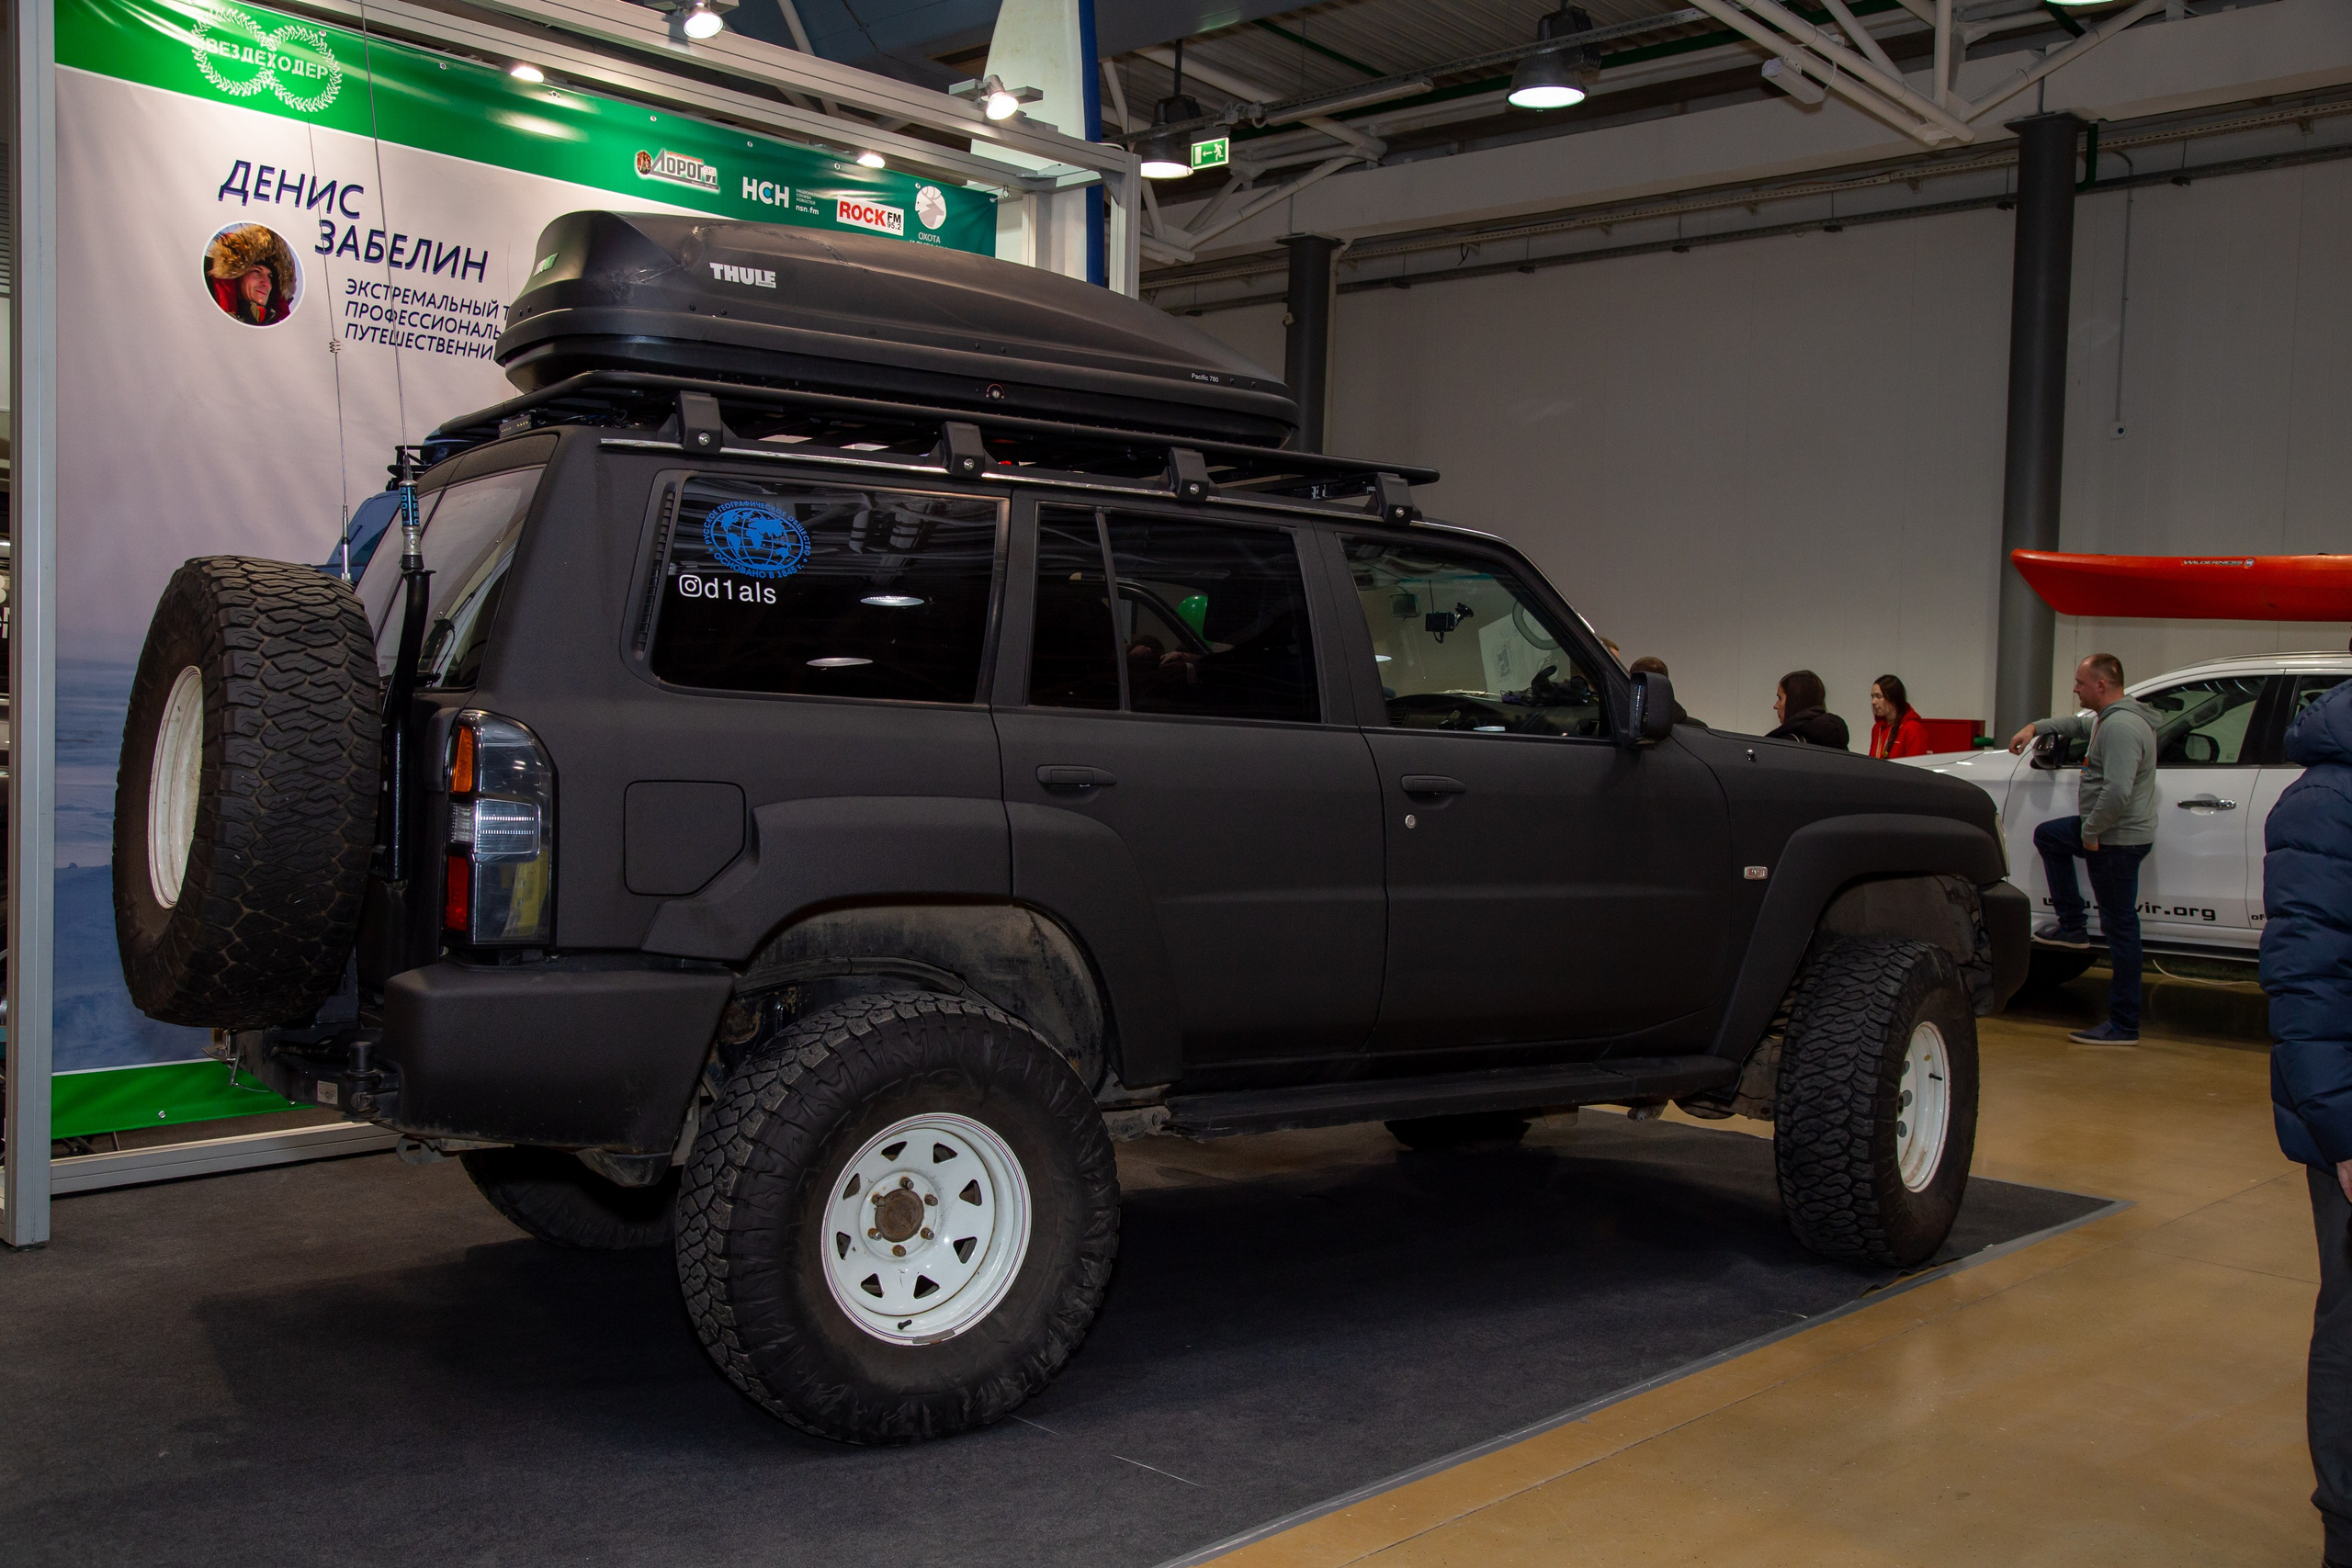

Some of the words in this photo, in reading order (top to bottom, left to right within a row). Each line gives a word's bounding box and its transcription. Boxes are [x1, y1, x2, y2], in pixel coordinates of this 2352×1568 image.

[204, 38, 329, 80] ВЕЗДЕХОДЕР
[218, 159, 364, 220] ДЕНИС
[742, 175, 789, 209] НСН
[796, 204, 820, 215] nsn.fm
[839, 200, 886, 227] ROCK
[887, 211, 901, 223] FM
[887, 221, 901, 230] 95.2
[918, 231, 941, 243] ОХОТА
[314, 219, 488, 283] ЗАБЕЛИН
[709, 262, 776, 288] THULE
[345, 278, 499, 320] ЭКСТРЕМАЛЬНЫЙ
[345, 300, 502, 340] ПРОФЕССИОНАЛЬ
[345, 322, 496, 361] ПУТЕШЕСТВЕННИ
[1191, 372, 1208, 380] Pacific
[703, 509, 718, 545] РУССКОЕ
[718, 501, 787, 516] ГЕОГРАФИЧЕСКОЕ
[787, 515, 811, 557] ОБЩЕСТВО
[714, 552, 766, 579] ОСНОВАНО
[776, 566, 797, 579] 1845
[704, 577, 776, 604] d1als
